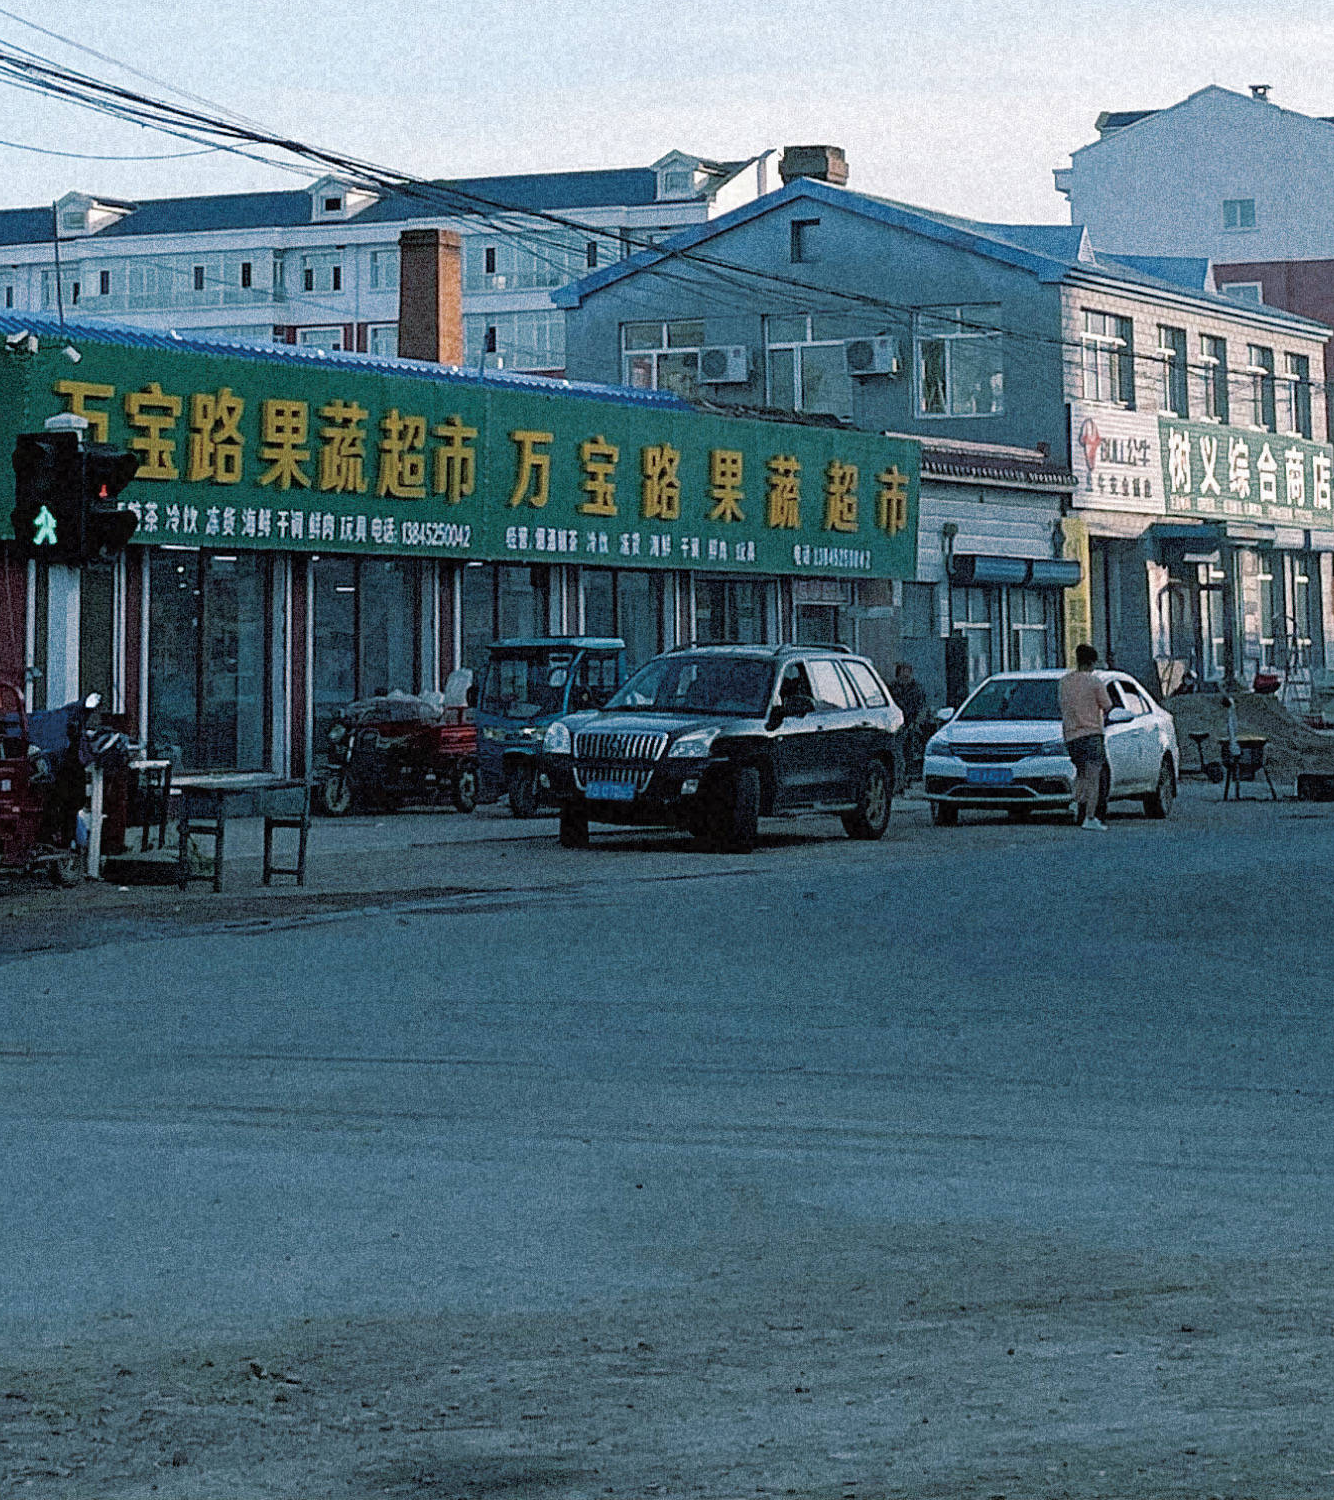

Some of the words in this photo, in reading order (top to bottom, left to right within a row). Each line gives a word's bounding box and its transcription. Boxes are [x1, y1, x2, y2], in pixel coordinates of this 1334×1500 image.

[55, 380, 477, 499] 万宝路果蔬超市
[509, 430, 908, 535] 万宝路果蔬超市
[1168, 427, 1331, 511] 树义综合商店
